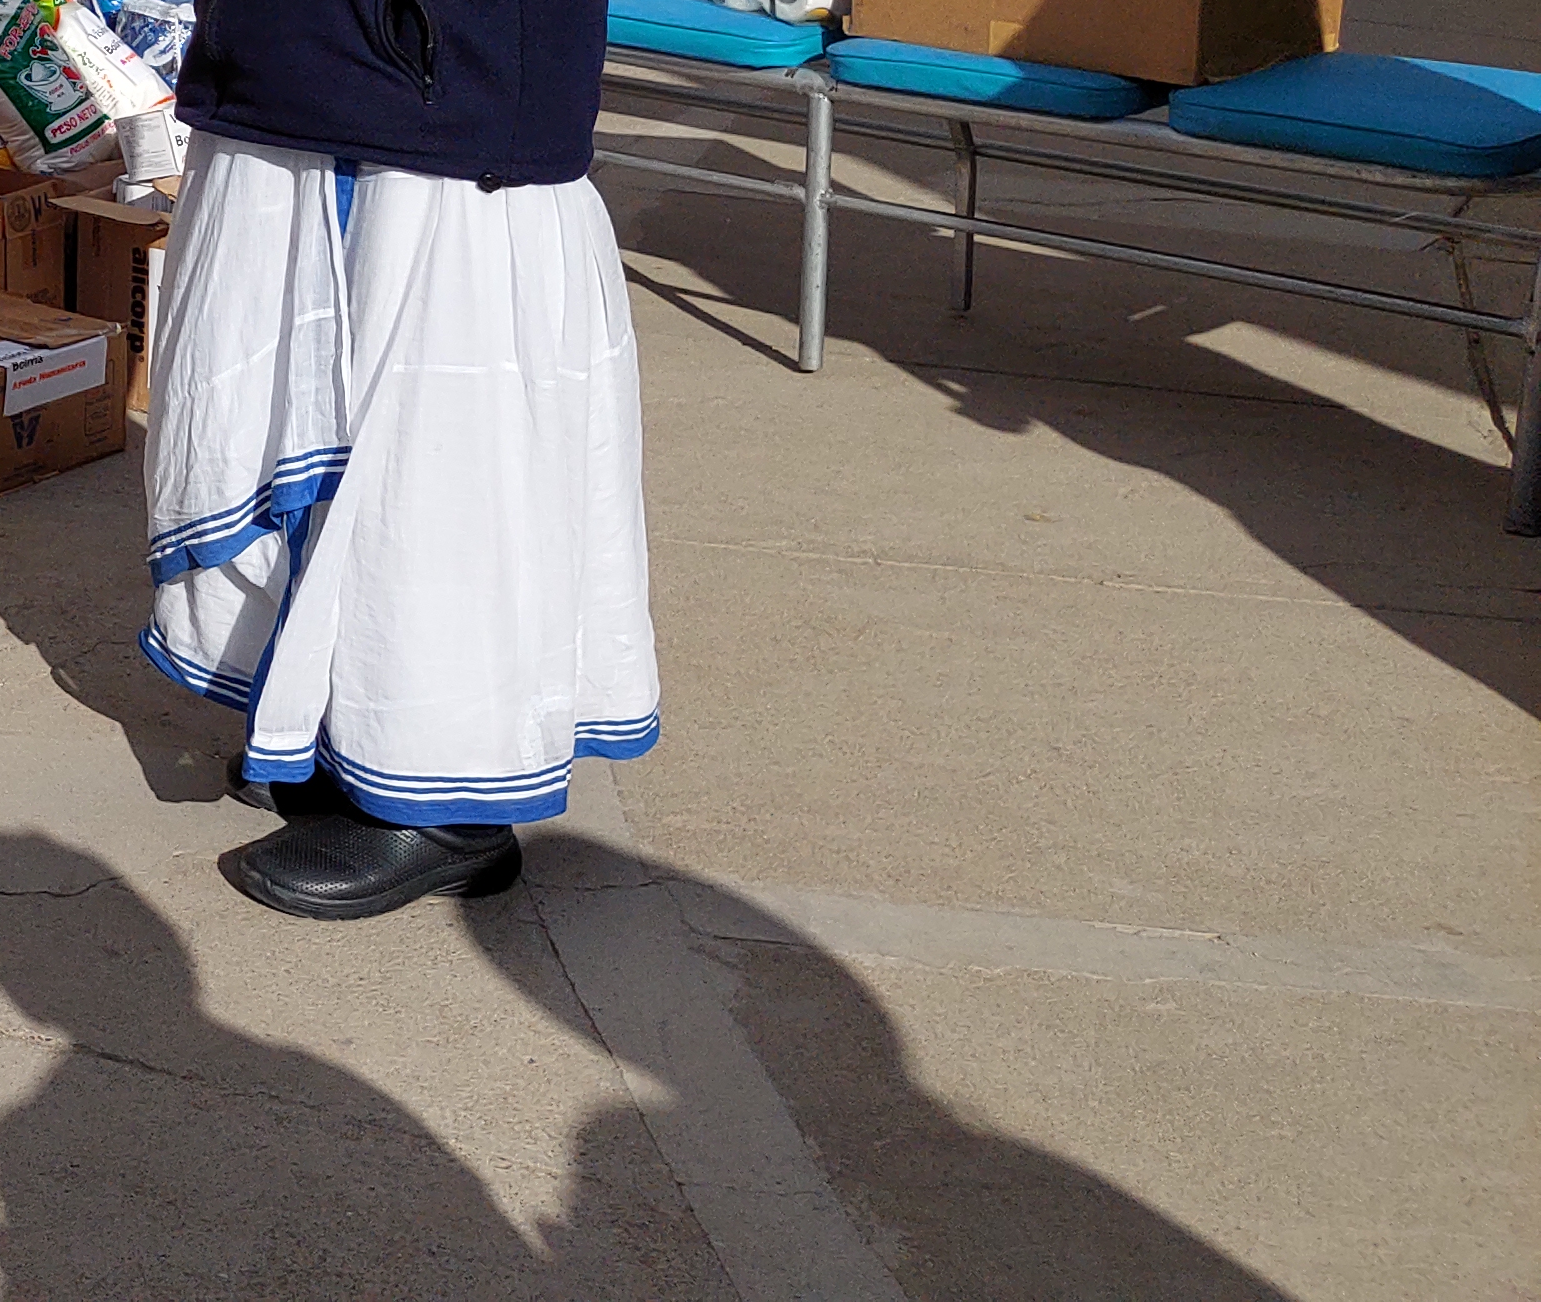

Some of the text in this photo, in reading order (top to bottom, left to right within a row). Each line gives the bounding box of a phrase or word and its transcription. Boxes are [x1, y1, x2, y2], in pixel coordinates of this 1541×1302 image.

[50, 104, 98, 139] PESO NETO
[127, 247, 149, 353] alicorp
[12, 360, 87, 391] Ayuda Humanitaria
